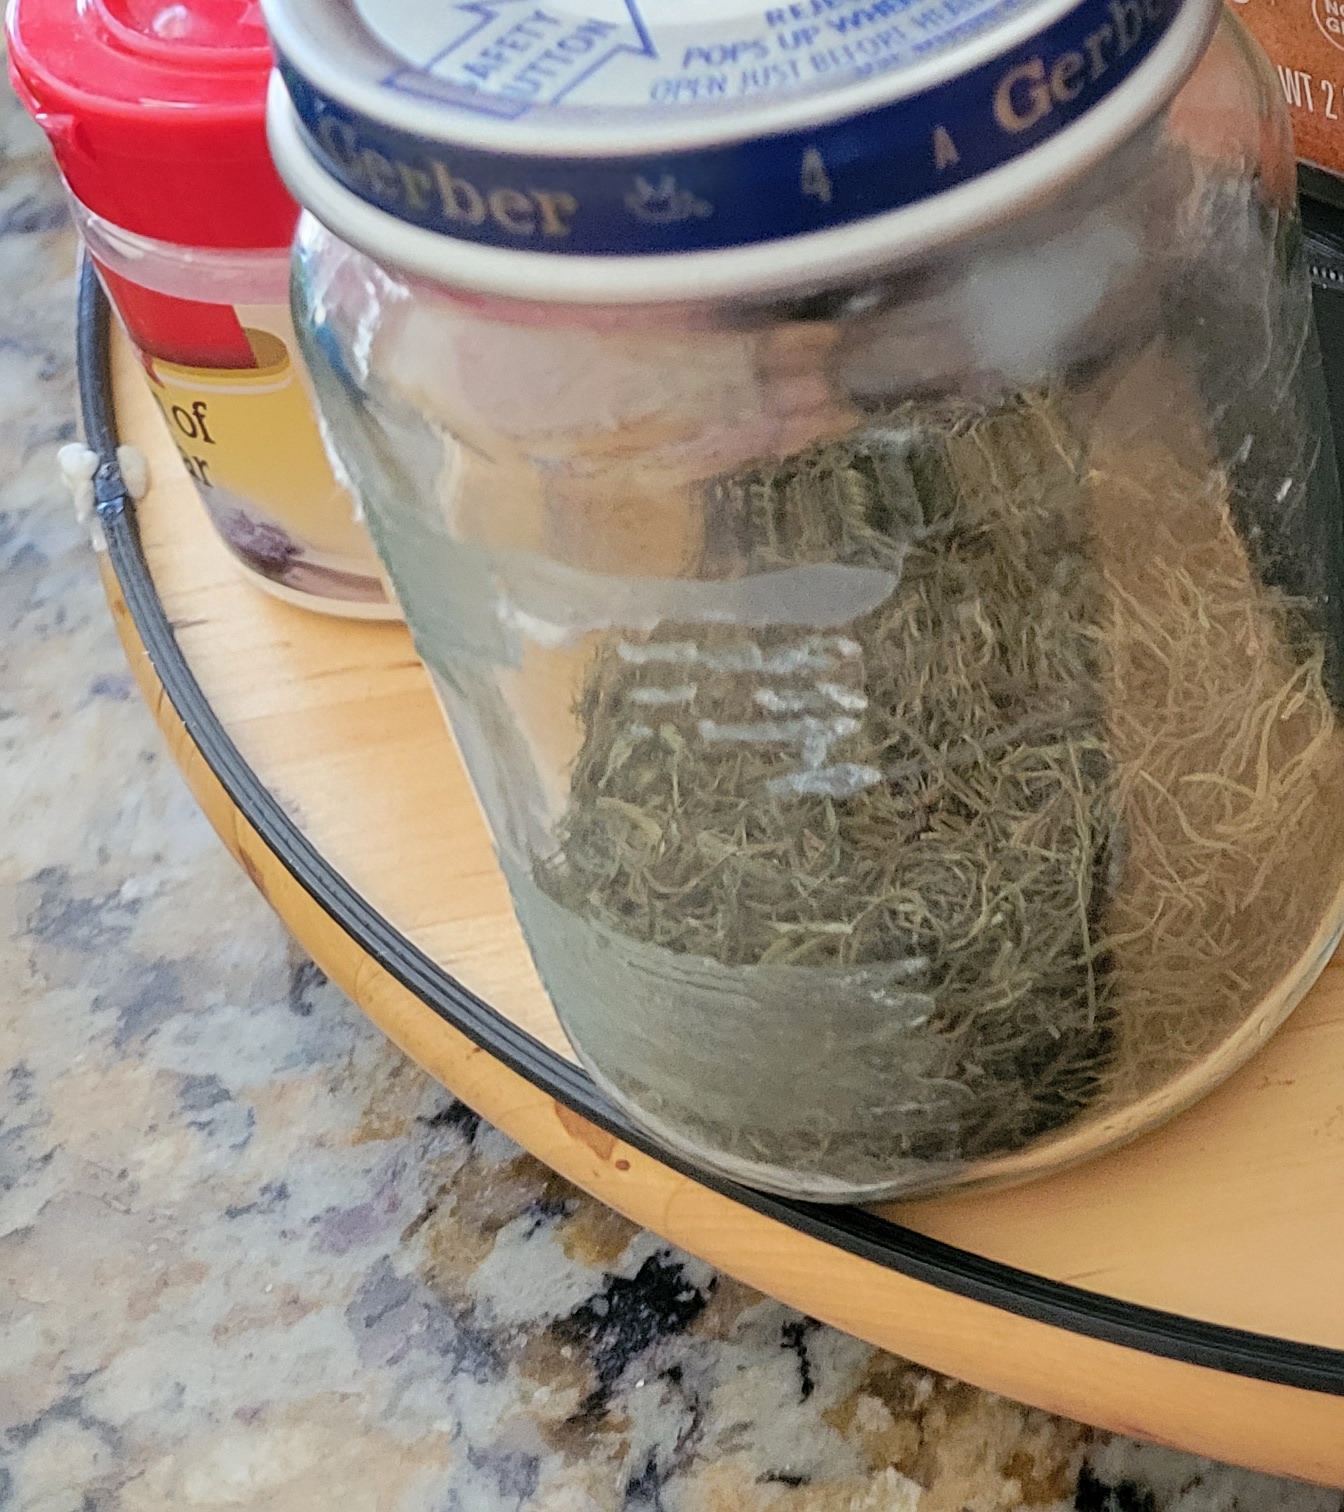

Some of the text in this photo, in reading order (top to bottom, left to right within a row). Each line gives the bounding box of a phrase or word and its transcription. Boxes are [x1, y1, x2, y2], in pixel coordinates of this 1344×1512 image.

[682, 38, 771, 69] POPS
[777, 24, 821, 50] UP
[1278, 65, 1316, 112] WT
[1321, 80, 1340, 121] 2
[171, 400, 217, 445] of
